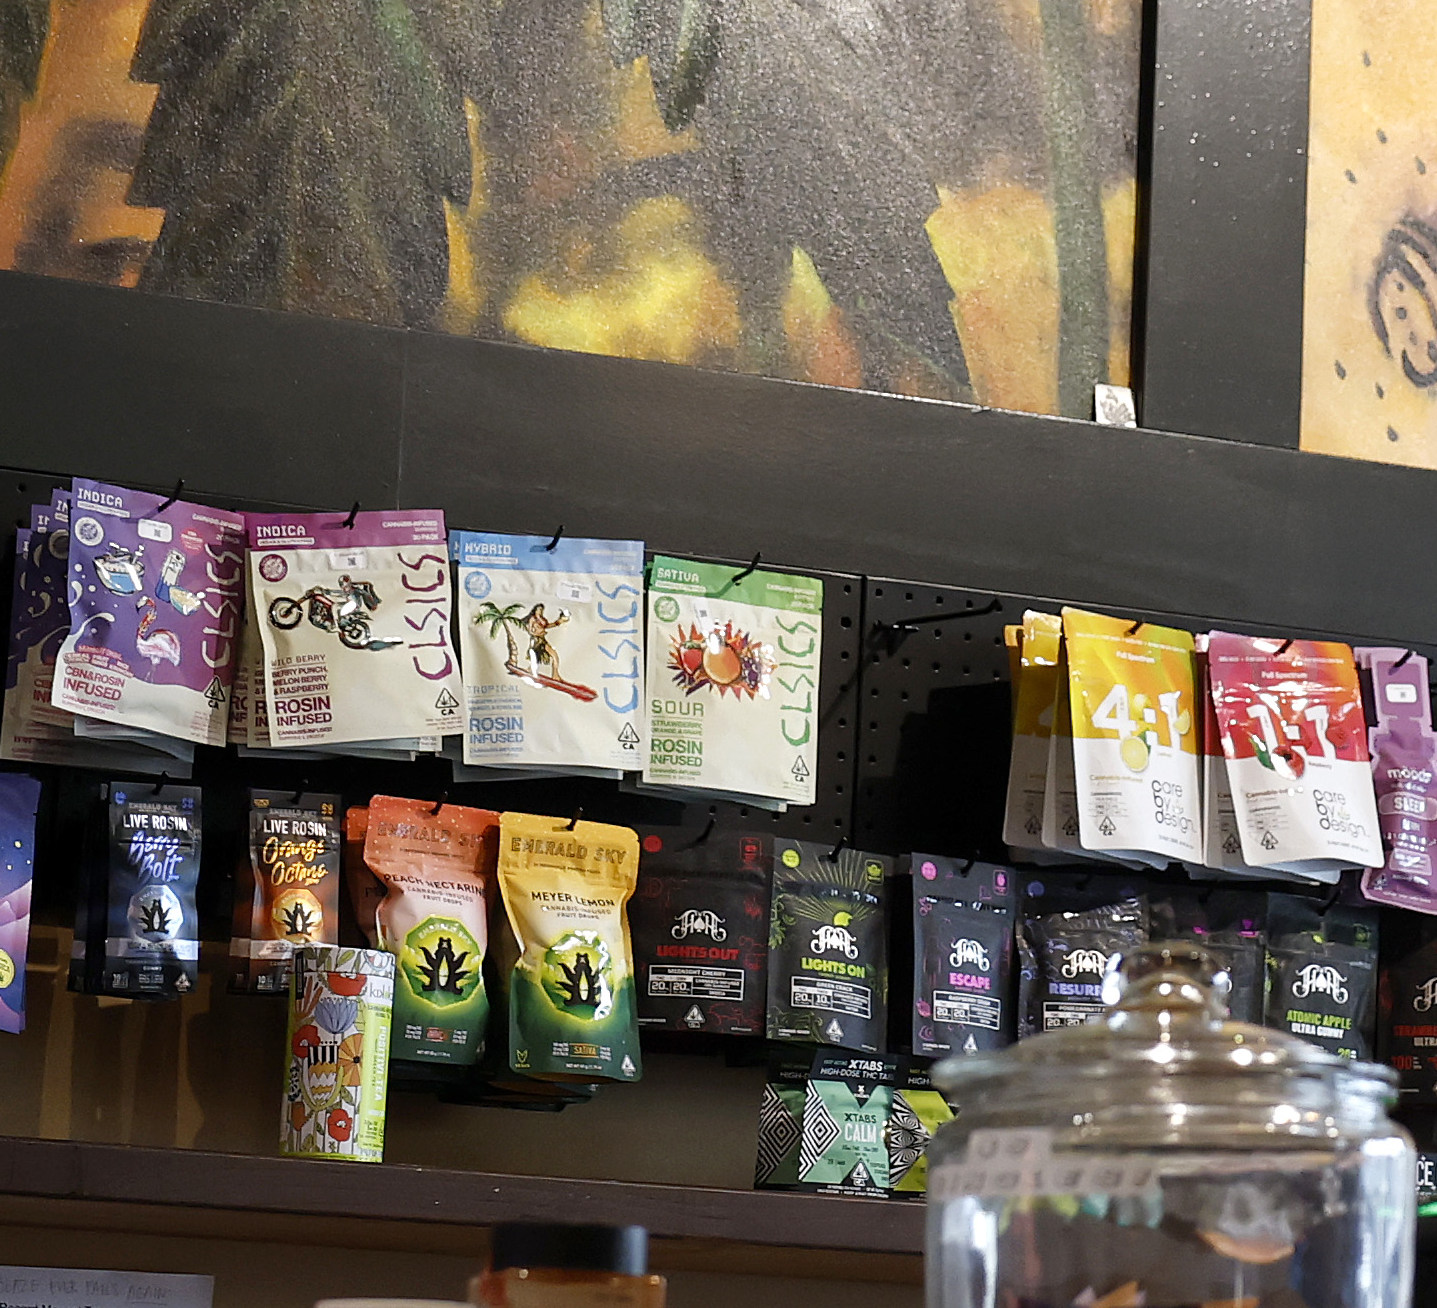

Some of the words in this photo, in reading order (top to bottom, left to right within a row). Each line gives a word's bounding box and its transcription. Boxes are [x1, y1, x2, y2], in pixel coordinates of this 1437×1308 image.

[77, 488, 123, 509] INDICA
[257, 525, 306, 537] INDICA
[465, 544, 512, 554] HYBRID
[656, 567, 699, 584] SATIVA
[296, 654, 326, 664] BERRY
[272, 668, 297, 678] BERRY
[273, 678, 299, 687] MELON
[300, 675, 327, 684] BERRY
[63, 678, 122, 701] INFUSED
[280, 684, 329, 694] RASPBERRY
[275, 695, 331, 714] ROSIN
[651, 699, 704, 717] SOUR
[277, 713, 332, 727] INFUSED
[469, 717, 524, 732] ROSIN
[1091, 684, 1183, 753] 4:1
[469, 733, 524, 744] INFUSED
[1246, 702, 1336, 760] 1:1
[650, 738, 703, 755] ROSIN
[650, 754, 703, 767] INFUSED
[1151, 780, 1183, 796] care
[1313, 789, 1346, 806] care
[122, 814, 149, 829] LIVE
[151, 815, 188, 832] ROSIN
[264, 819, 290, 834] LIVE
[292, 821, 327, 837] ROSIN
[511, 837, 587, 860] EMERALD
[593, 848, 628, 865] SKY
[383, 873, 424, 885] PEACH
[531, 891, 572, 903] MEYER
[574, 896, 615, 908] LEMON
[656, 945, 705, 959] LIGHTS
[706, 947, 740, 960] OUT
[801, 957, 847, 976] LIGHTS
[847, 963, 866, 979] ON
[949, 972, 991, 989] ESCAPE
[1286, 1009, 1321, 1026] ATOMIC
[1322, 1013, 1352, 1030] APPLE
[1291, 1022, 1315, 1036] ULTRA
[1316, 1026, 1345, 1040] GUMMY
[820, 1068, 861, 1078] HIGH-DOSE
[862, 1071, 877, 1079] THC
[848, 1059, 884, 1072] XTABS
[844, 1113, 876, 1124] XTABS
[845, 1124, 876, 1143] CALM
